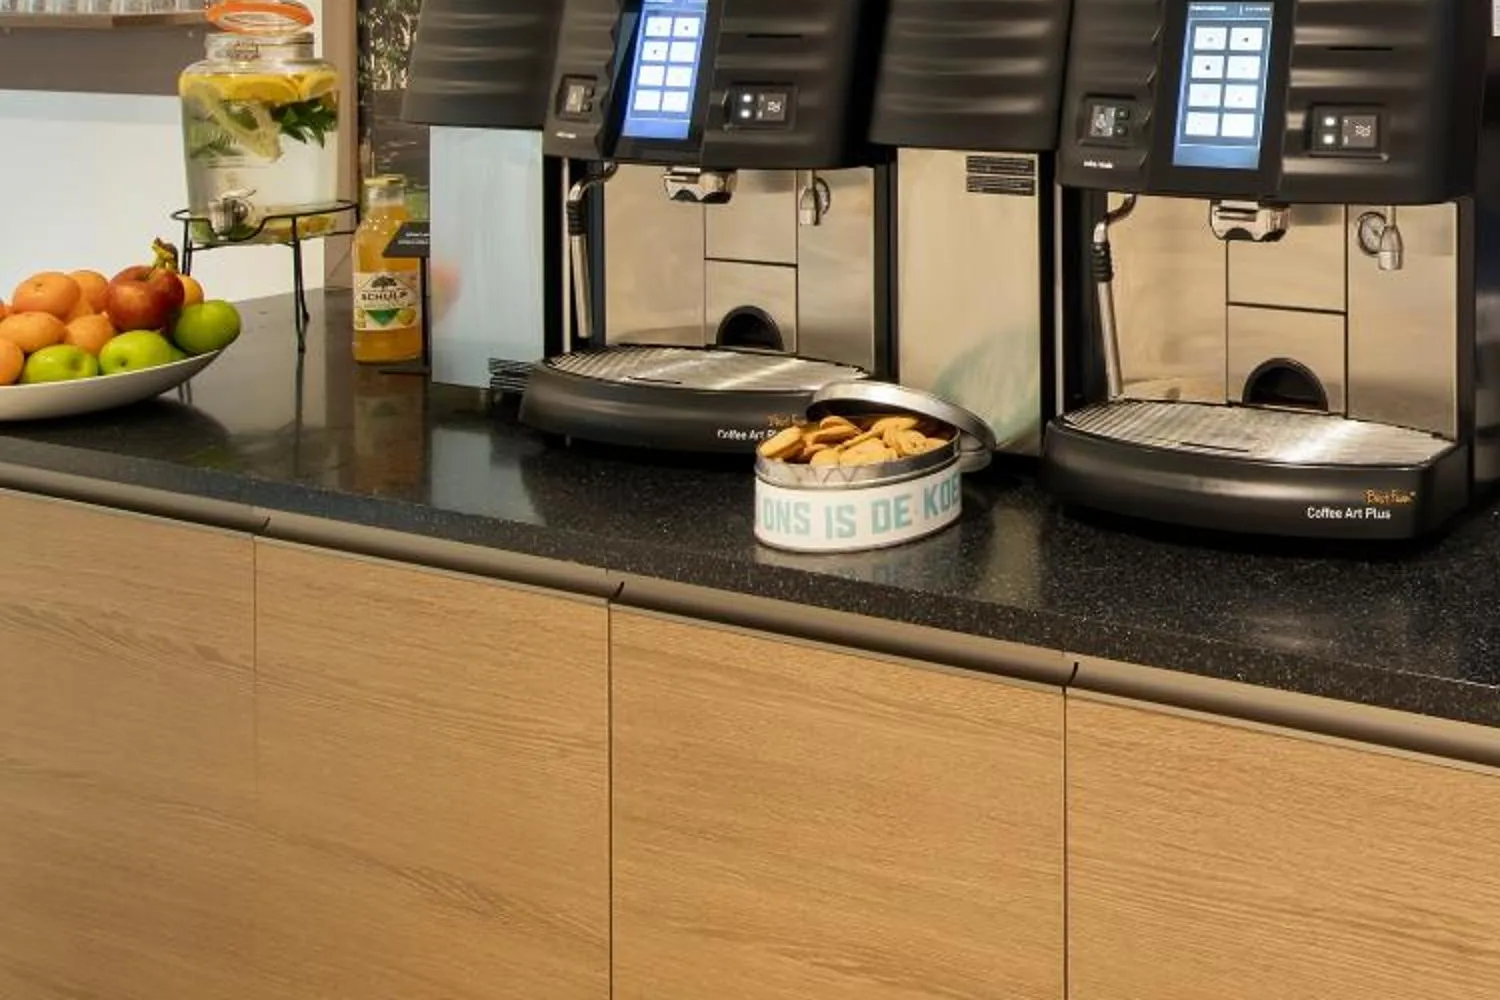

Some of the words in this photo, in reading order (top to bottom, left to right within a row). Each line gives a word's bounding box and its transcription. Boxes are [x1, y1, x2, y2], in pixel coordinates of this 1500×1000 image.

[762, 496, 812, 535] ONS
[824, 503, 857, 539] IS
[871, 494, 913, 534] DE
[1307, 507, 1342, 519] Coffee
[1344, 507, 1363, 519] Art
[1365, 507, 1391, 519] Plus
